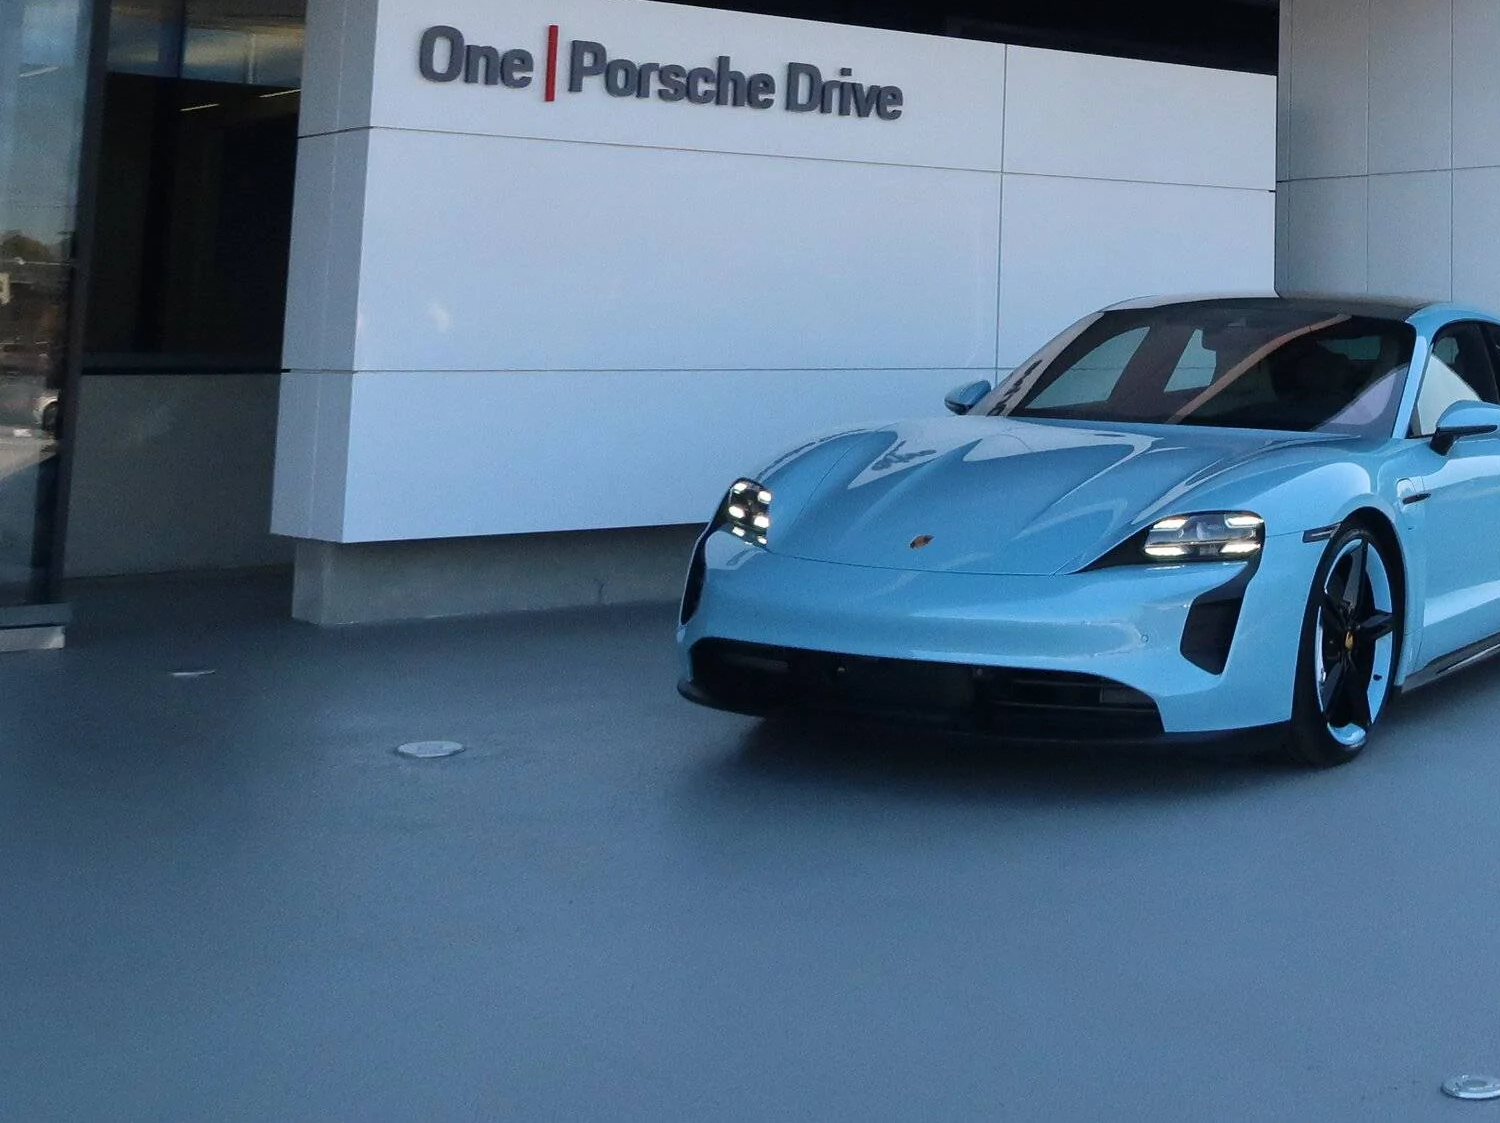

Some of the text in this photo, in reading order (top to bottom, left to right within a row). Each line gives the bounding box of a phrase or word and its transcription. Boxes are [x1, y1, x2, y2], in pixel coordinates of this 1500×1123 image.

[419, 25, 904, 121] One Porsche Drive
